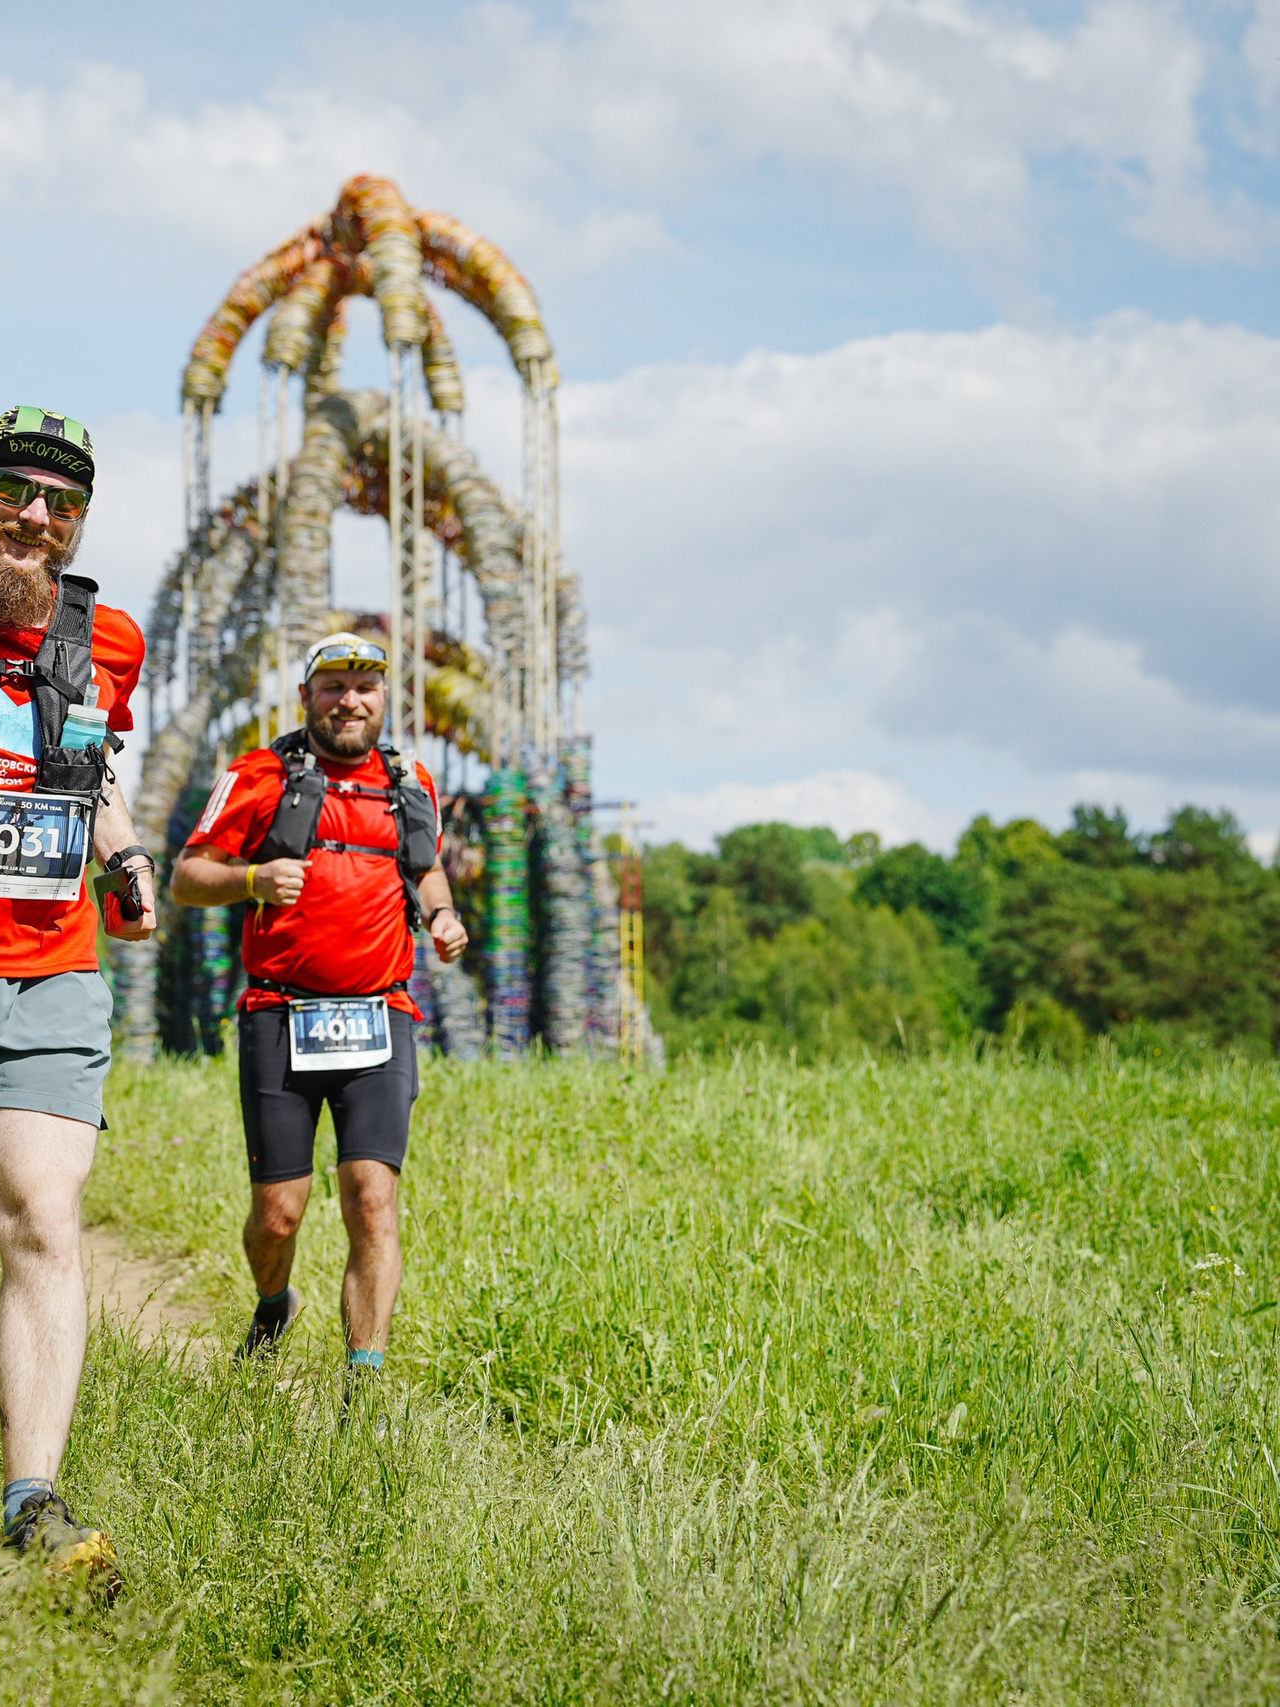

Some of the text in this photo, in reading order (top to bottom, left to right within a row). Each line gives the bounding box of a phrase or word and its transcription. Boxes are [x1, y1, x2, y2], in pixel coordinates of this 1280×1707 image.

[20, 801, 33, 810] 50
[34, 802, 49, 811] KM
[308, 1018, 373, 1041] 4011
